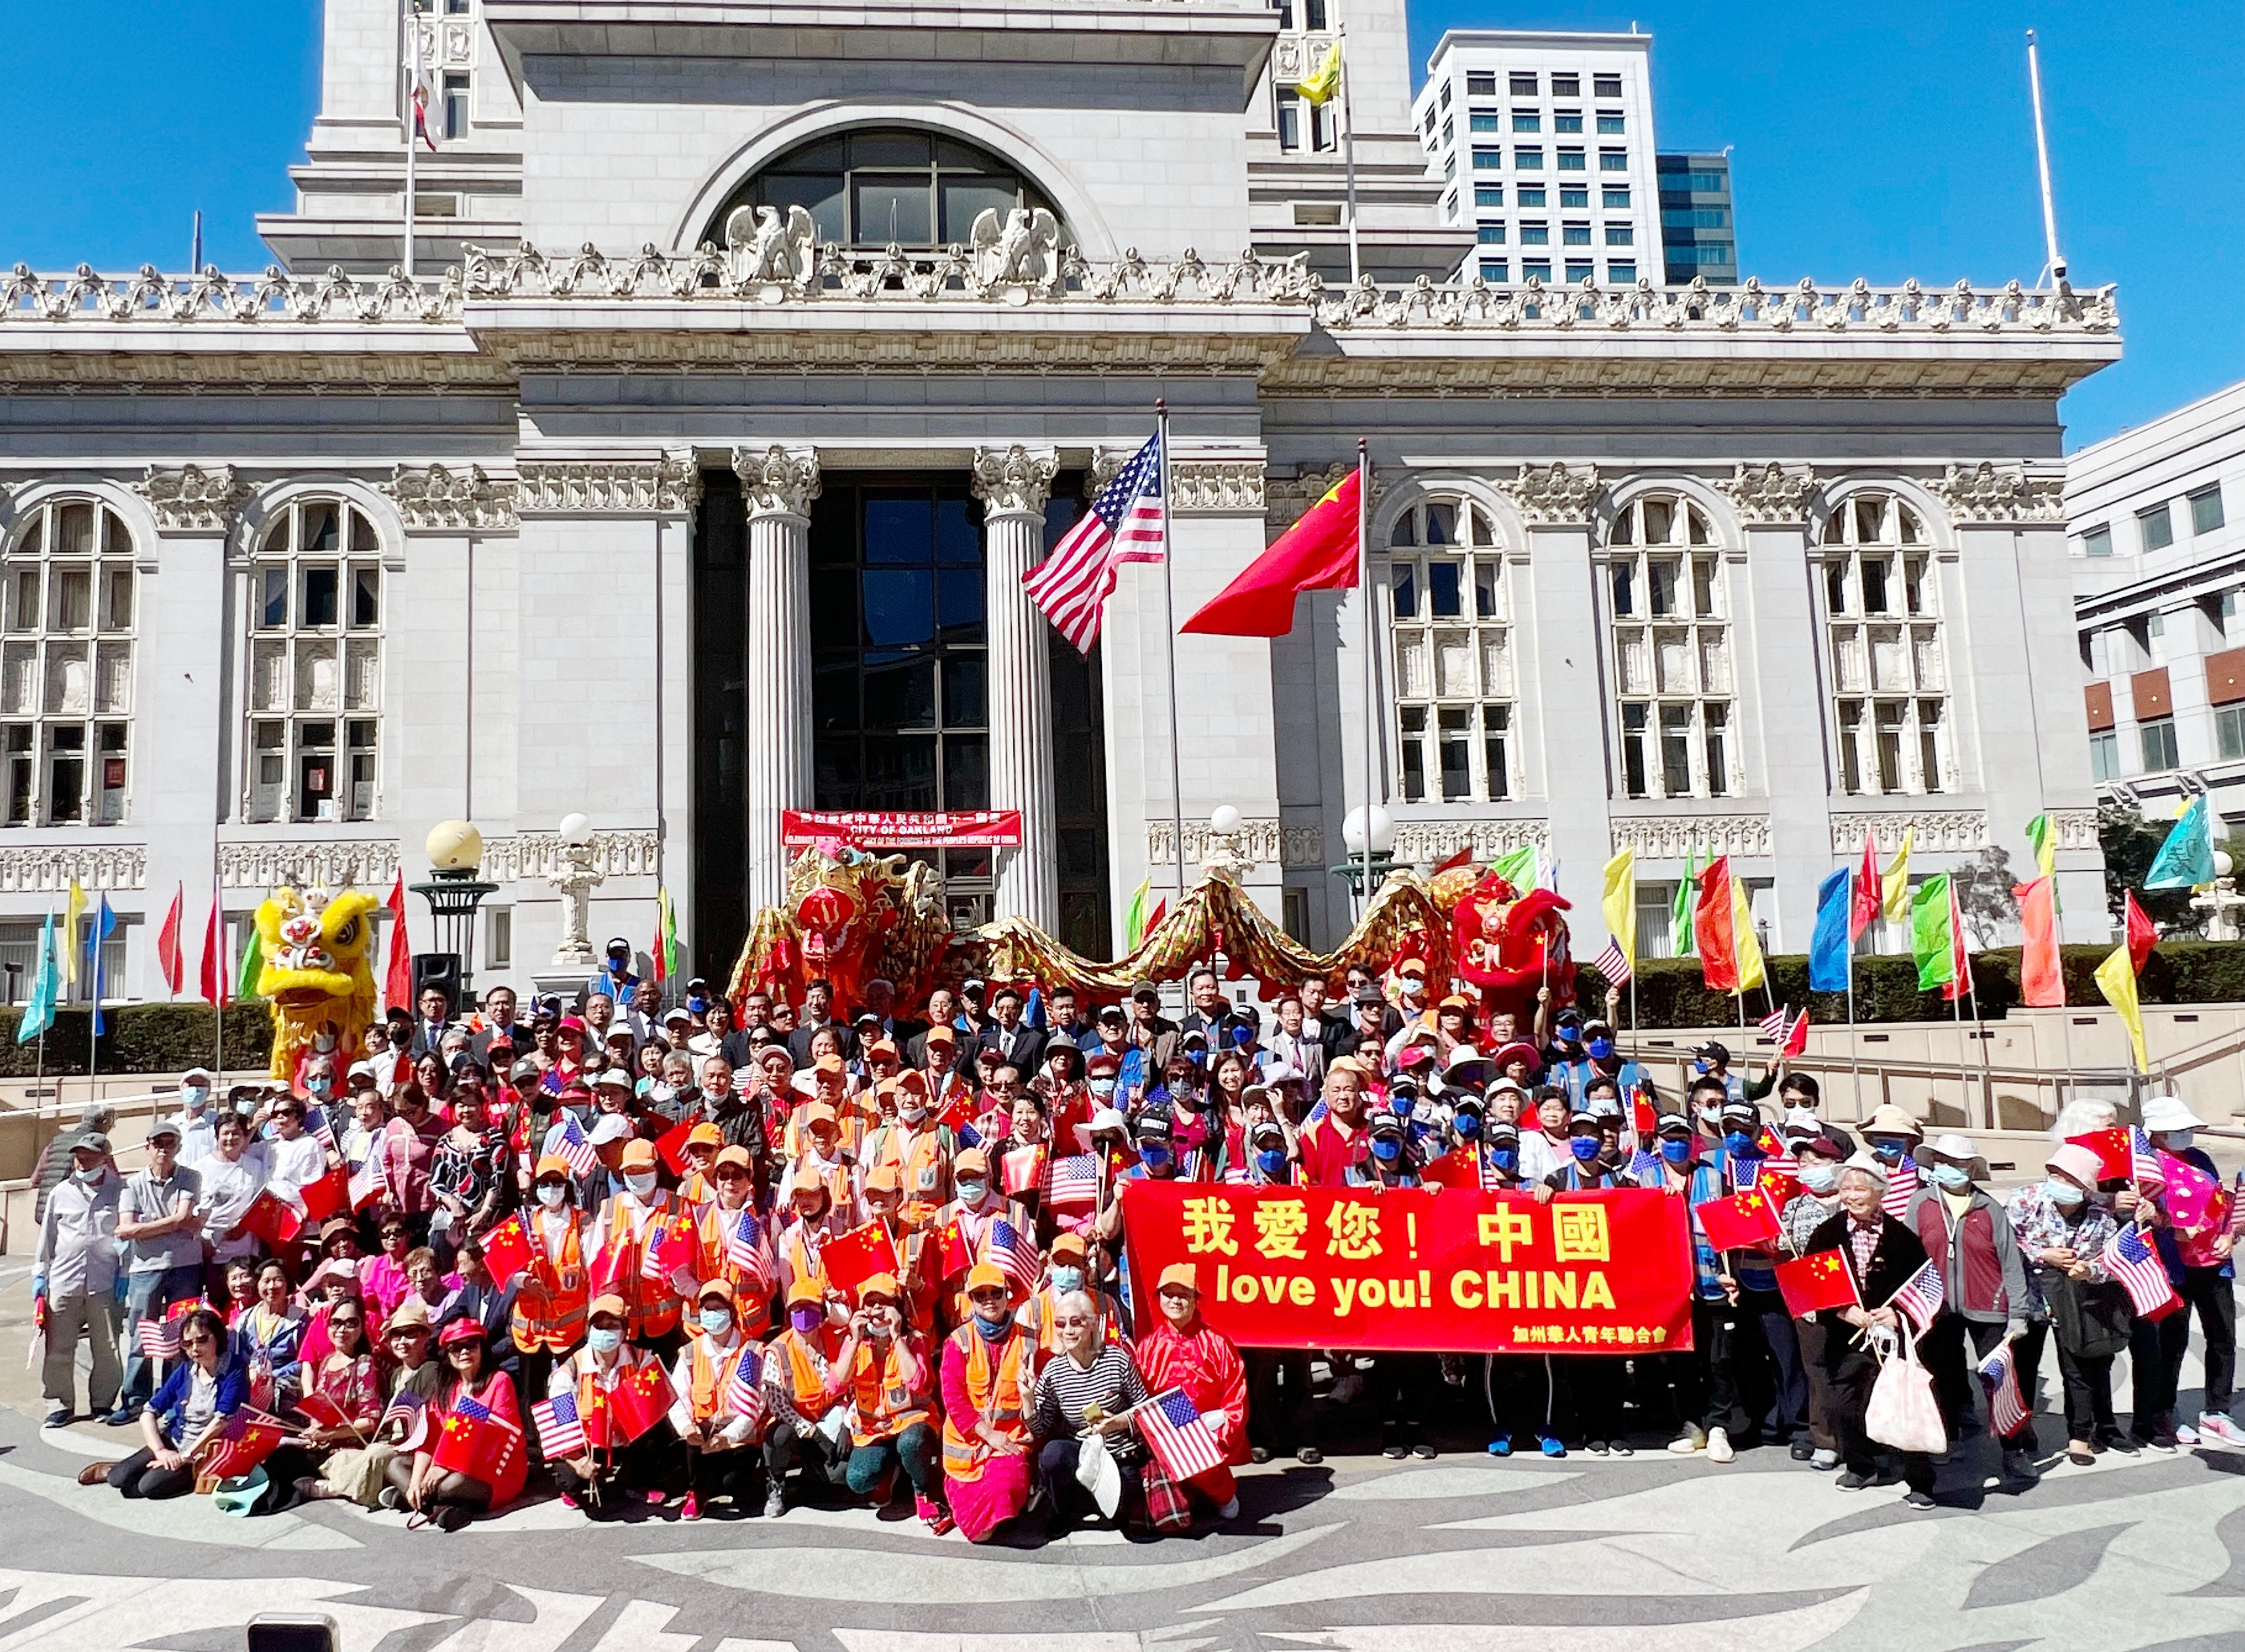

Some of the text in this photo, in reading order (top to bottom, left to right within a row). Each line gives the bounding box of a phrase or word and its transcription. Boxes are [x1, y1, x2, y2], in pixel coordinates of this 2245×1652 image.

[850, 825, 953, 835] CITY OF OAKLAND
[1477, 1201, 1610, 1263] 中國
[1216, 1264, 1616, 1317] love you! CHINA
[1512, 1325, 1666, 1344] 加州華人青年聯合會
